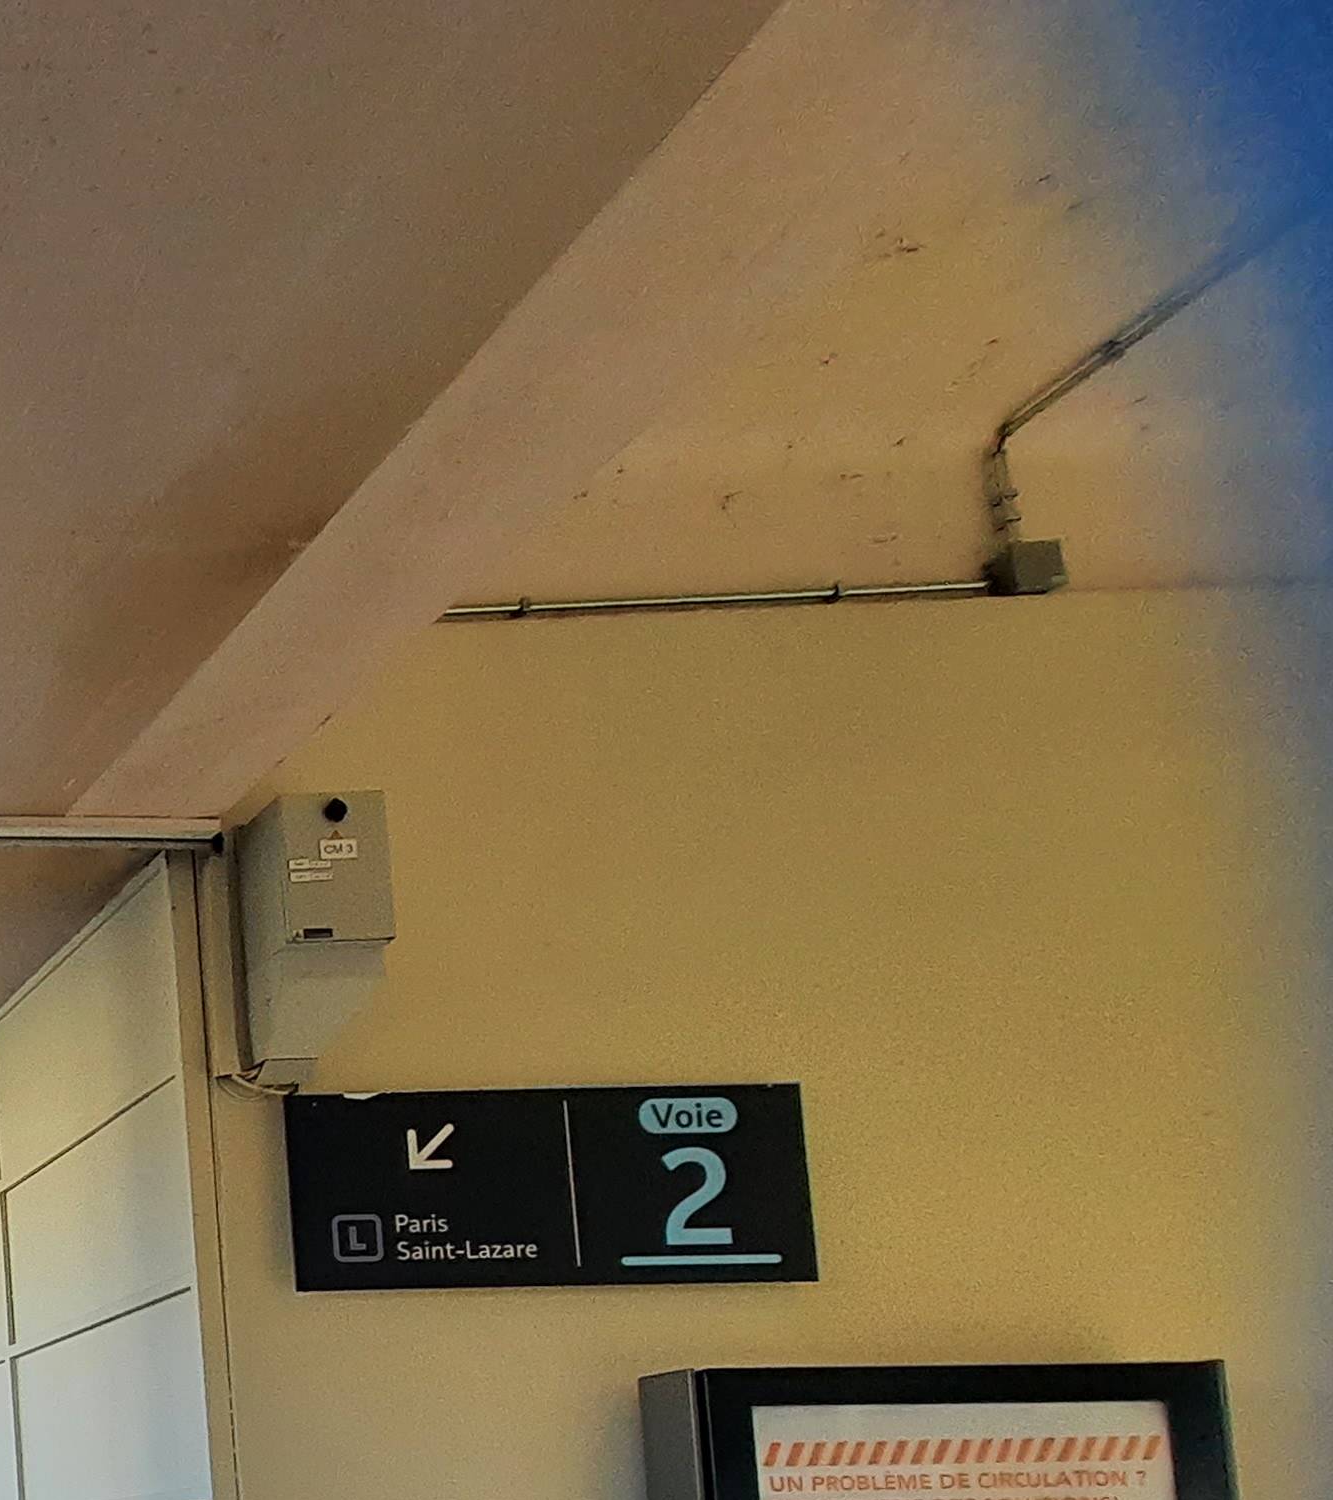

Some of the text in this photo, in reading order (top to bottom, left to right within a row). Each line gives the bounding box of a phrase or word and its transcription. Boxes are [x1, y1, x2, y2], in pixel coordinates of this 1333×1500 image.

[650, 1102, 724, 1129] Voie
[660, 1146, 734, 1246] 2
[395, 1214, 449, 1233] Paris
[348, 1225, 367, 1250] L
[397, 1240, 538, 1260] Saint-Lazare
[769, 1475, 804, 1492] UN
[812, 1471, 933, 1492] PROBLÈME
[940, 1473, 972, 1489] DE
[978, 1470, 1129, 1489] CIRCULATION
